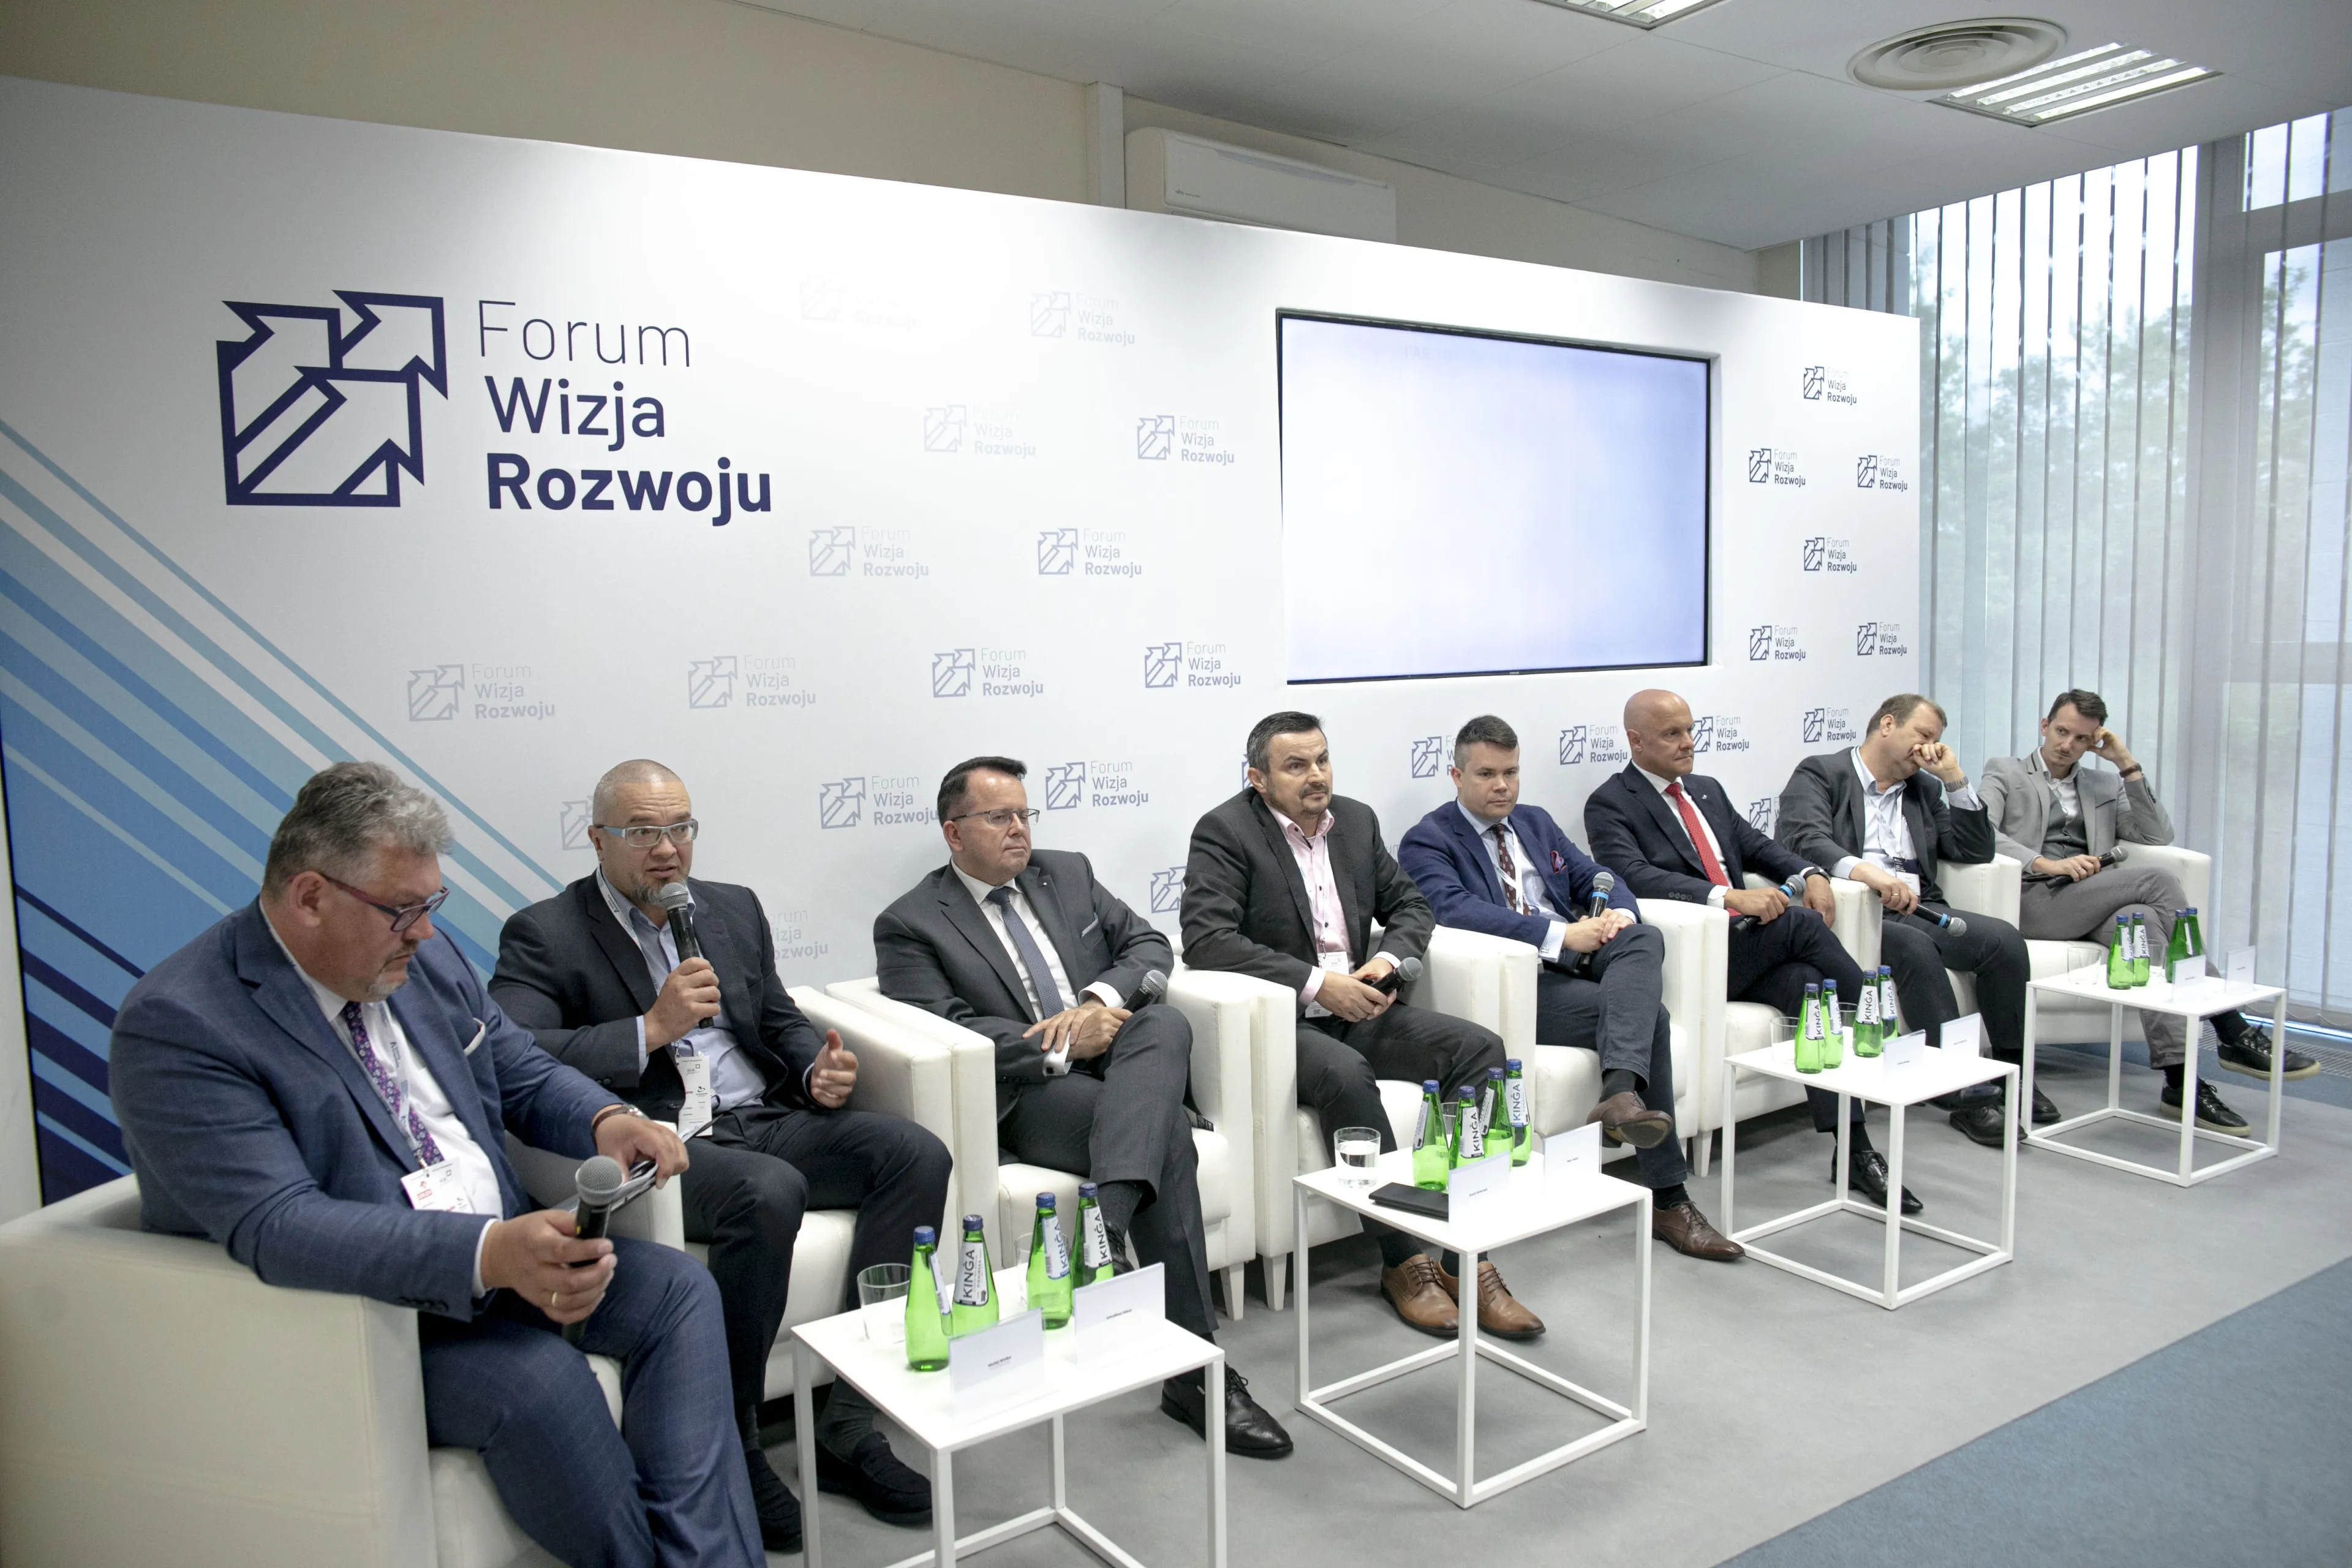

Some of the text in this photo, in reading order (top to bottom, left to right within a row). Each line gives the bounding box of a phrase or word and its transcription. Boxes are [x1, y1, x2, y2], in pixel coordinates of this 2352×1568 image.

[1076, 294, 1119, 311] Forum
[1077, 311, 1114, 328] Wizja
[478, 300, 690, 368] Forum
[1077, 328, 1135, 347] Rozwoju
[1828, 380, 1846, 392] Wizja
[1827, 393, 1857, 405] Rozwoju
[484, 375, 665, 452] Wizja
[974, 423, 1012, 440] Wizja
[1180, 417, 1219, 431] Forum
[1181, 432, 1215, 449] Wizja
[974, 441, 1036, 458] Rozwoju
[1181, 449, 1235, 466] Rozwoju
[1774, 450, 1797, 461] Forum
[1775, 462, 1794, 473] Wizja
[1880, 456, 1900, 467] Forum
[1775, 474, 1806, 488] Rozwoju
[1880, 467, 1898, 480] Wizja
[486, 452, 771, 526] Rozwoju
[1880, 480, 1908, 492] Rozwoju
[861, 526, 911, 542] Forum
[1084, 528, 1126, 544] Forum
[1827, 537, 1849, 548] Forum
[864, 544, 905, 561] Wizja
[1085, 545, 1121, 561] Wizja
[1828, 550, 1846, 561] Wizja
[863, 562, 930, 579] Rozwoju
[1085, 562, 1143, 578] Rozwoju
[1828, 562, 1857, 574] Rozwoju
[1774, 625, 1798, 636] Forum
[1879, 622, 1900, 631] Forum
[1775, 638, 1795, 649] Wizja
[1880, 634, 1897, 644] Wizja
[981, 646, 1027, 661] Forum
[1187, 641, 1226, 654] Forum
[1775, 650, 1806, 661] Rozwoju
[1879, 646, 1907, 657] Rozwoju
[472, 662, 532, 679] Forum
[744, 654, 796, 671] Forum
[1188, 656, 1222, 672] Wizja
[982, 663, 1021, 680] Wizja
[745, 673, 790, 690] Wizja
[1188, 672, 1242, 688] Rozwoju
[473, 682, 525, 701] Wizja
[982, 680, 1044, 698] Rozwoju
[746, 691, 816, 708] Rozwoju
[475, 702, 556, 721] Rozwoju
[1827, 707, 1849, 717] Forum
[1716, 715, 1741, 726] Forum
[1828, 719, 1845, 730] Wizja
[1589, 725, 1618, 736] Forum
[1717, 728, 1737, 739] Wizja
[1827, 730, 1856, 741] Rozwoju
[1591, 737, 1614, 751] Wizja
[1717, 740, 1749, 751] Rozwoju
[1590, 749, 1628, 763] Rozwoju
[1090, 758, 1133, 773] Forum
[872, 775, 919, 790] Forum
[1092, 774, 1128, 791] Wizja
[873, 791, 913, 809] Wizja
[1092, 790, 1149, 807] Rozwoju
[873, 807, 938, 825] Rozwoju
[767, 910, 807, 924] orum
[774, 941, 828, 960] ozwoju
[1511, 1084, 1521, 1121] KINGA
[1470, 1112, 1481, 1152] KINGA
[1094, 1213, 1108, 1259] KINGA
[963, 1249, 975, 1298] KINGA
